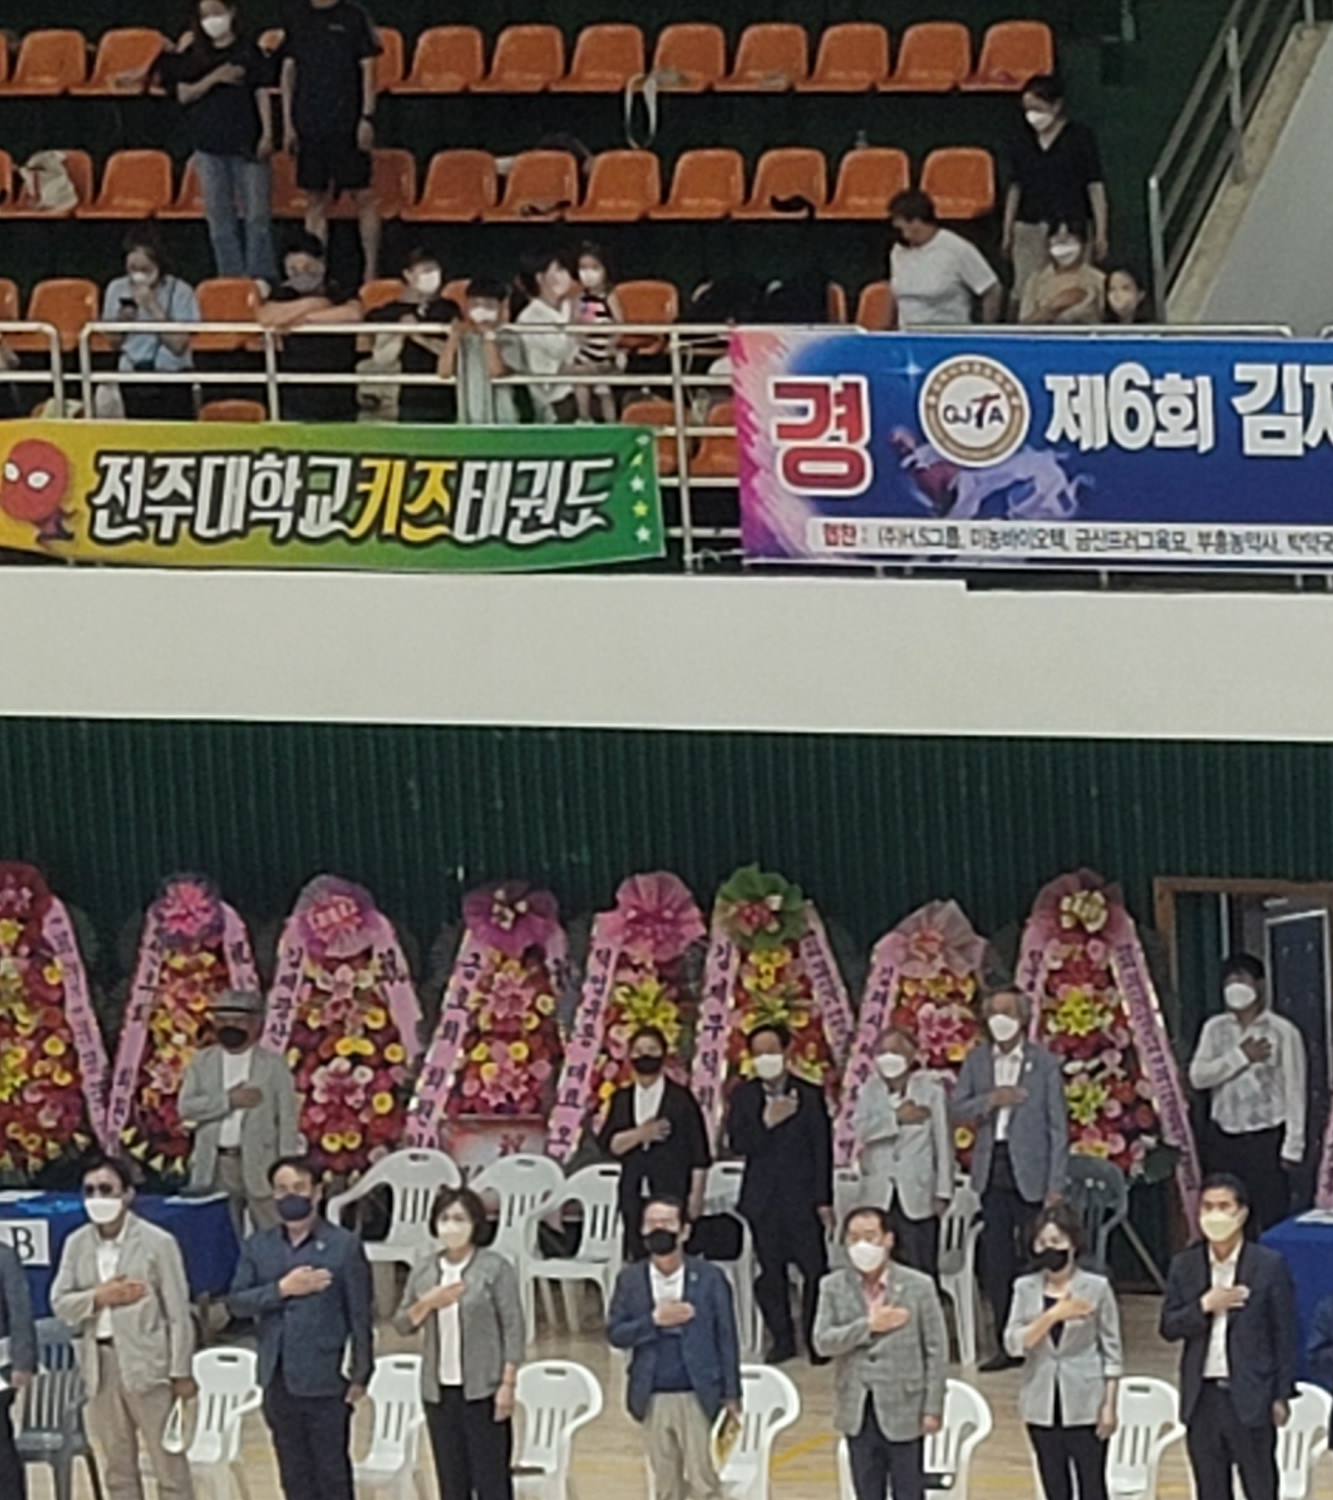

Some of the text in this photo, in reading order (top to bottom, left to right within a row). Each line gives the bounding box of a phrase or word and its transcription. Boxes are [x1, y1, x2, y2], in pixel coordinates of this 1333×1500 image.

[772, 378, 869, 493] 경
[1043, 361, 1215, 454] 제6회
[91, 453, 614, 542] 전주대학교키즈태권도
[10, 1226, 35, 1261] B
